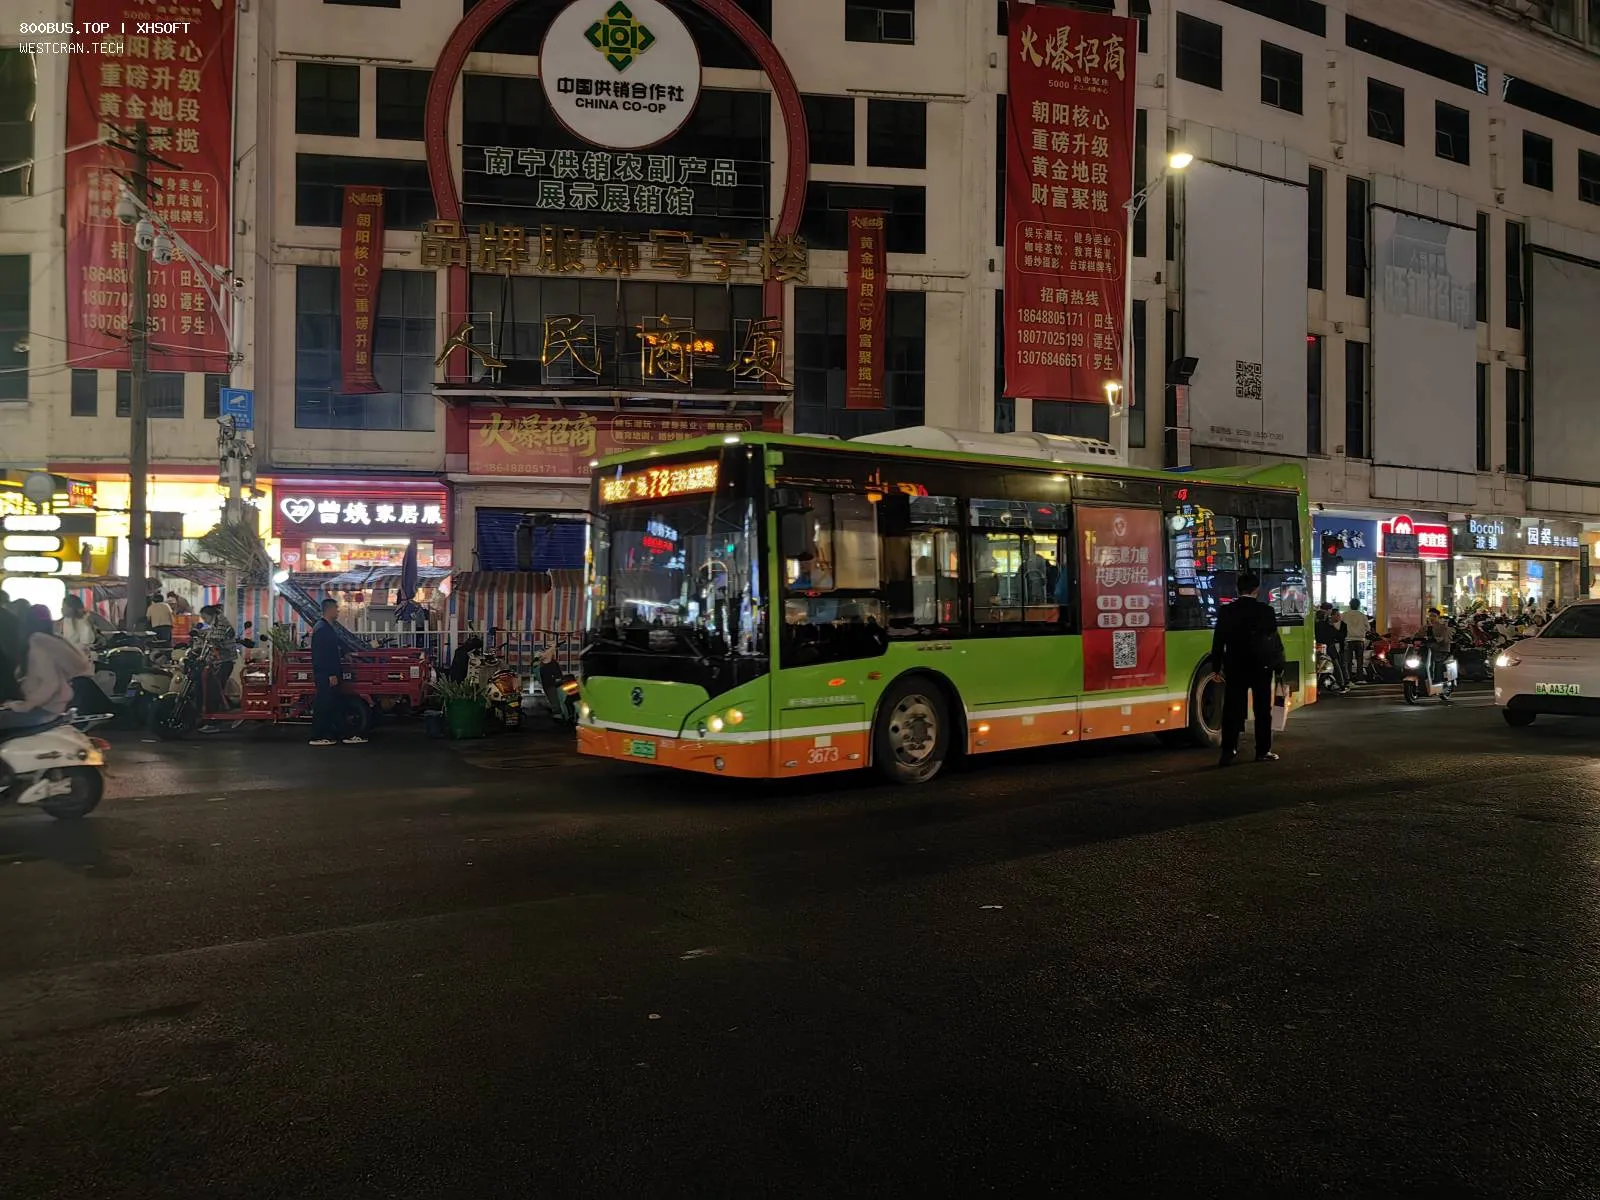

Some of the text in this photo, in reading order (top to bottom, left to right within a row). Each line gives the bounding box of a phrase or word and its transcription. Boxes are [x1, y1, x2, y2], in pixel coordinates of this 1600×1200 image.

[102, 33, 203, 62] 朝阳核心
[1020, 25, 1126, 81] 火爆招商
[100, 63, 201, 92] 重磅升级
[557, 77, 685, 102] 中国供销合作社
[98, 92, 200, 122] 黄金地段
[575, 97, 667, 114] CHINA CO-OP
[1032, 100, 1110, 131] 朝阳核心
[1032, 128, 1109, 158] 重磅升级
[484, 147, 738, 187] 南宁供销农副产品
[1032, 156, 1109, 185] 黄金地段
[536, 181, 695, 216] 展示展销馆
[1032, 183, 1109, 212] 财富聚揽
[111, 242, 186, 262] 招线
[354, 214, 371, 277] 朝阳核心
[420, 219, 809, 284] 品牌服饰写字楼
[860, 236, 874, 297] 黄金地段
[1040, 287, 1099, 307] 招商热线
[355, 298, 369, 365] 重磅升级
[1017, 309, 1083, 326] 18648805171
[434, 313, 795, 388] 人民商厦
[858, 317, 873, 381] 财富聚揽
[1017, 329, 1083, 347] 18077025199
[1017, 350, 1083, 368] 13076846651
[480, 412, 598, 457] 火爆招商
[1418, 532, 1448, 548] 美宜佳
[808, 747, 839, 764] 3673
